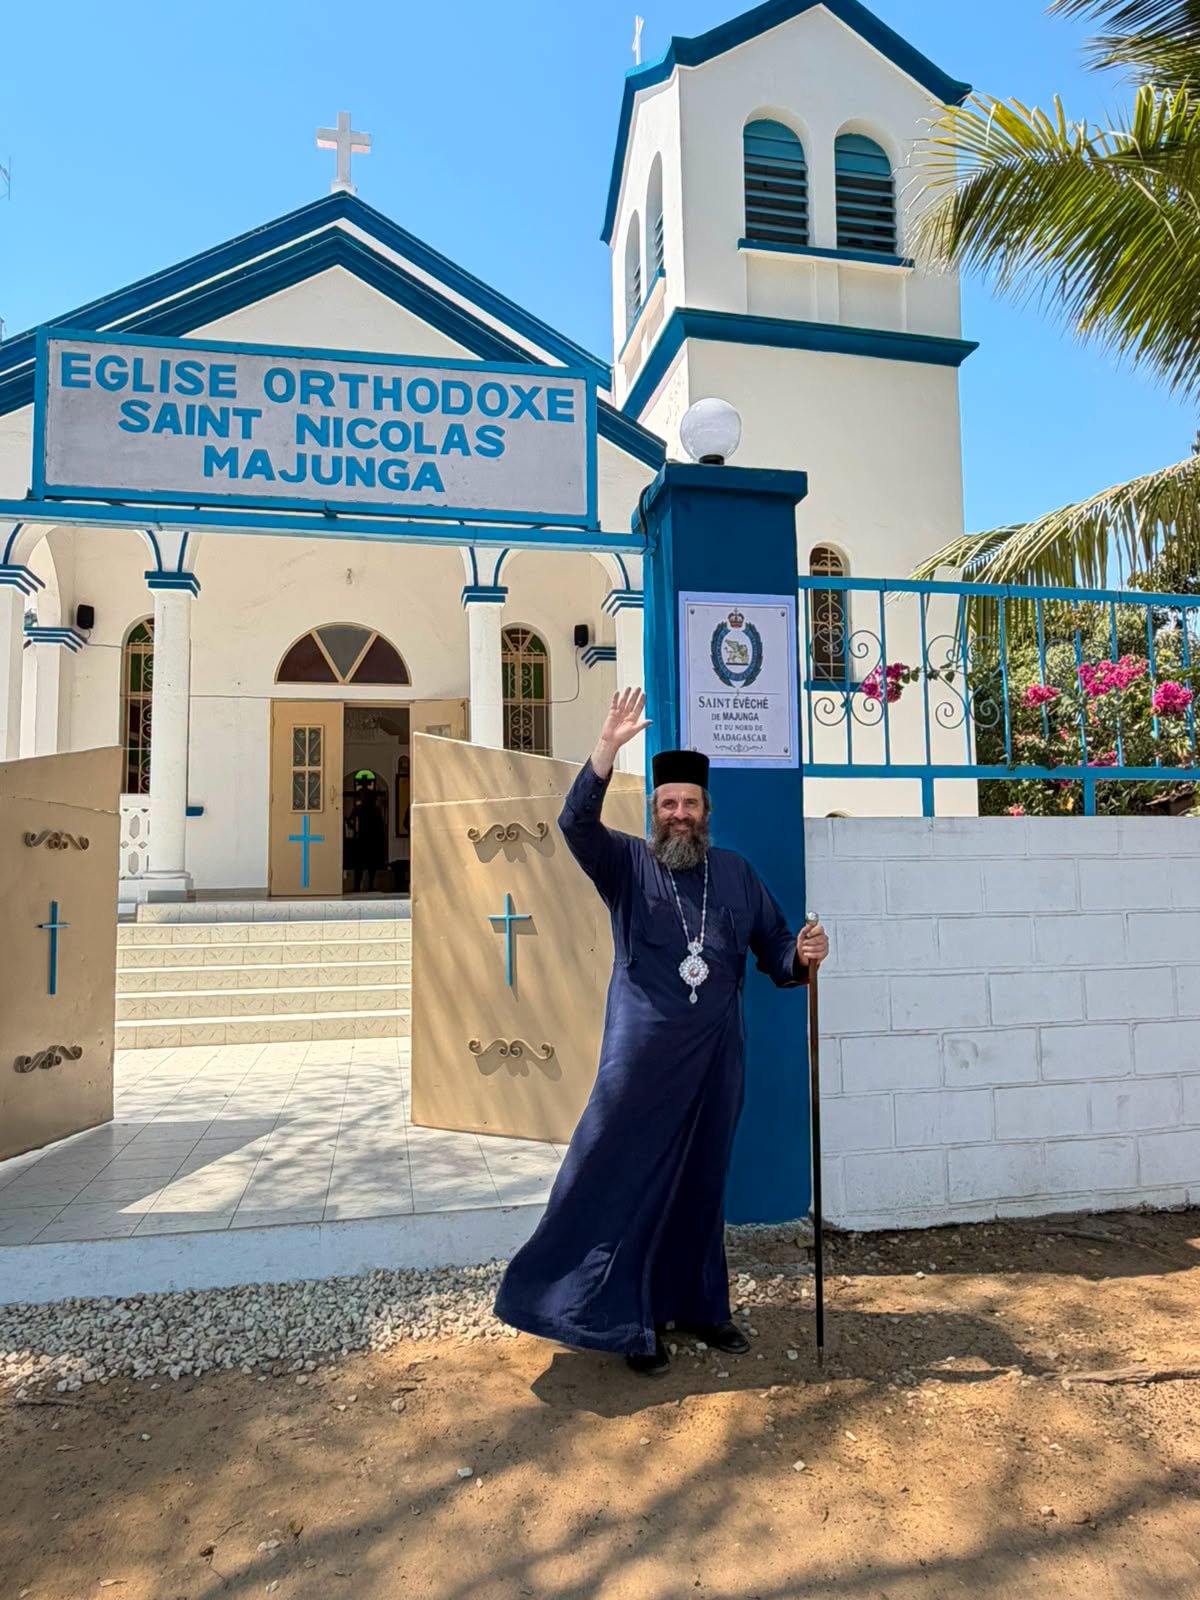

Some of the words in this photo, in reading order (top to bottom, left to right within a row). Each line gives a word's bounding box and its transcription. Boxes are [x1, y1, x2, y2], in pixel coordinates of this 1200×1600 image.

[61, 352, 237, 398] EGLISE
[263, 367, 575, 423] ORTHODOXE
[119, 400, 262, 440] SAINT
[295, 413, 506, 458] NICOLAS
[203, 445, 446, 493] MAJUNGA
[698, 696, 731, 708] SAINT
[733, 696, 769, 709] ÉVÊCHÉ
[711, 713, 721, 721] DE
[722, 712, 759, 721] MAJUNGA
[712, 732, 767, 742] MADAGASCAR
